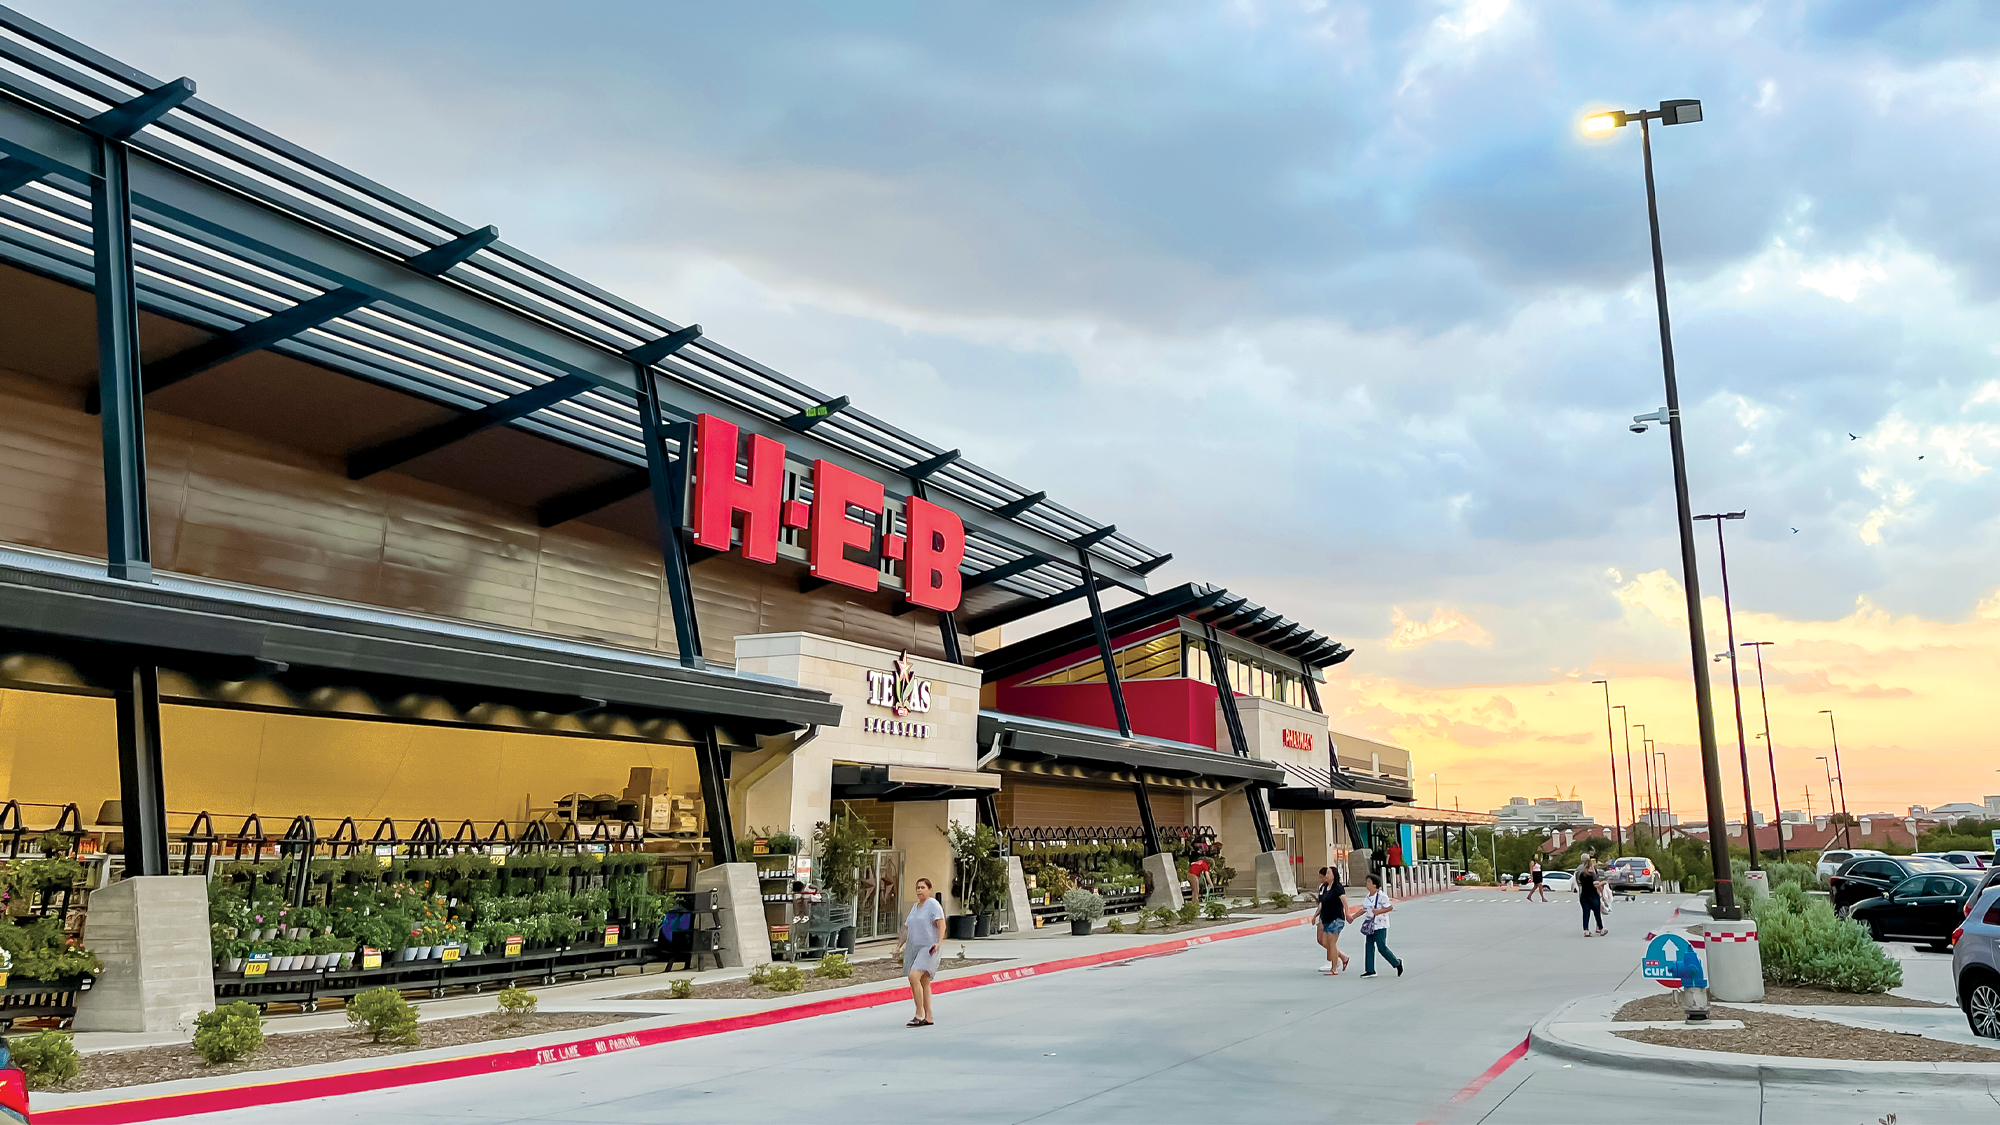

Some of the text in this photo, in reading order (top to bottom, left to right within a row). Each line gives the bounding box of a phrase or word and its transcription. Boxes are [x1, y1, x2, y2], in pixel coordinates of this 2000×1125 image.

[694, 413, 965, 612] H-E-B
[867, 664, 932, 714] TEXAS
[865, 717, 931, 738] BACKYARD
[537, 1048, 557, 1063] FIRE
[559, 1045, 580, 1059] LANE
[595, 1041, 607, 1052] NO
[608, 1036, 640, 1051] PARKING
